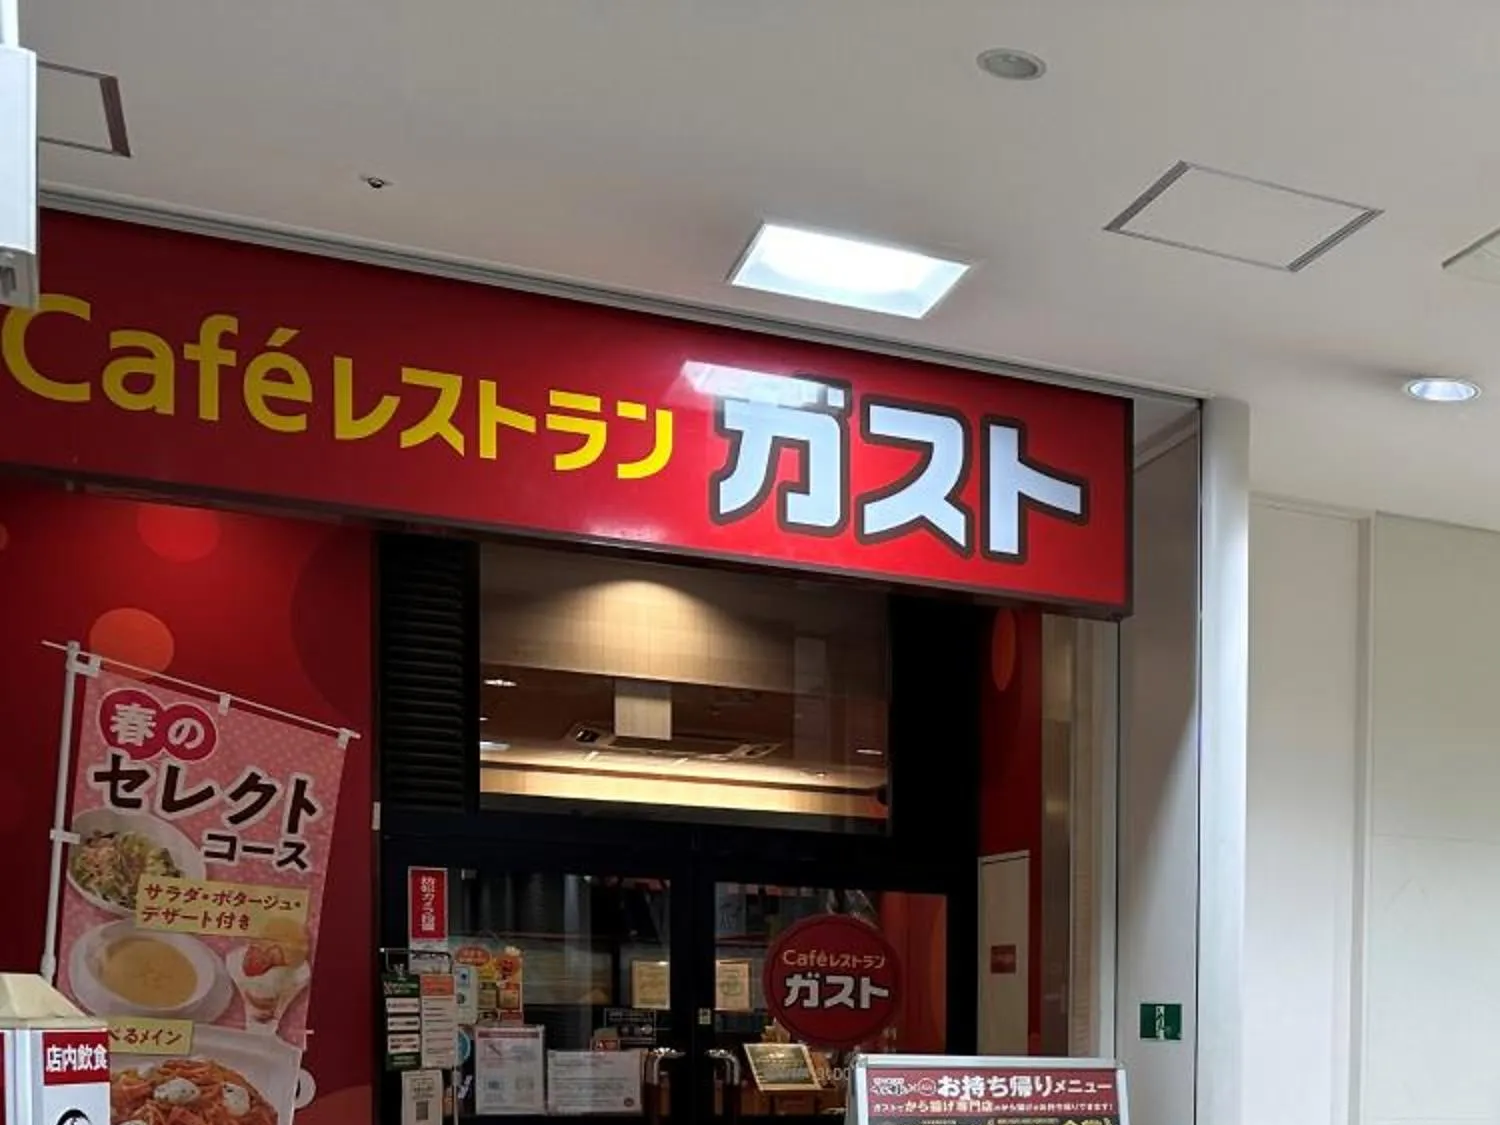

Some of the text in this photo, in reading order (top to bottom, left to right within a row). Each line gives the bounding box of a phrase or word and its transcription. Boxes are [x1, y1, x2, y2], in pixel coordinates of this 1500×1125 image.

[2, 294, 1089, 564] Café レストラン ガスト
[109, 703, 205, 749] 春の
[93, 754, 318, 835] セレクト
[204, 833, 307, 869] コース
[142, 908, 250, 931] デザート付き
[829, 955, 886, 969] レストラン
[783, 973, 889, 1010] ガスト
[45, 1044, 108, 1073] 店内飲食
[938, 1075, 1112, 1099] お持ち帰りメニュー
